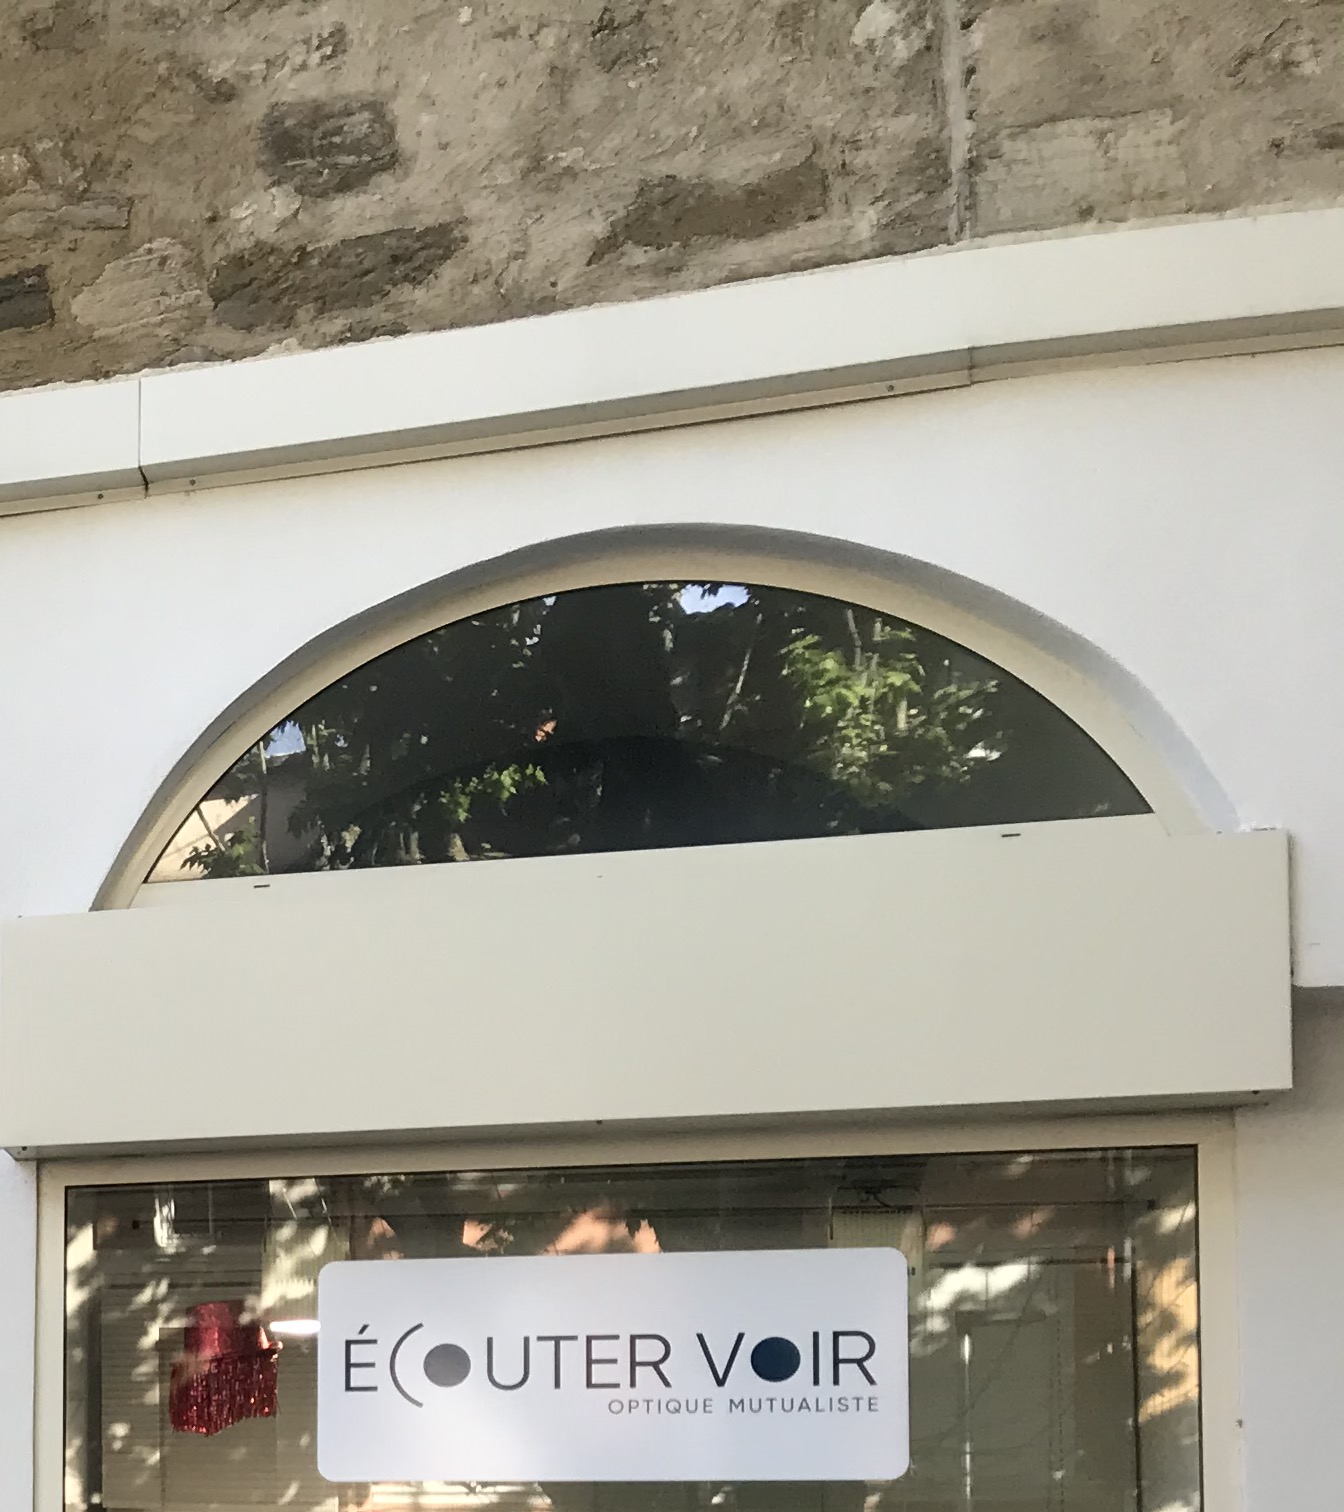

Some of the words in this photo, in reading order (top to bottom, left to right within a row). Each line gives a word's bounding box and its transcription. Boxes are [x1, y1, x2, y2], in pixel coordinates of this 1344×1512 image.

[344, 1322, 672, 1408] ÉCOUTER
[696, 1330, 879, 1390] VOIR
[607, 1397, 715, 1415] OPTIQUE
[728, 1395, 880, 1413] MUTUALISTE
